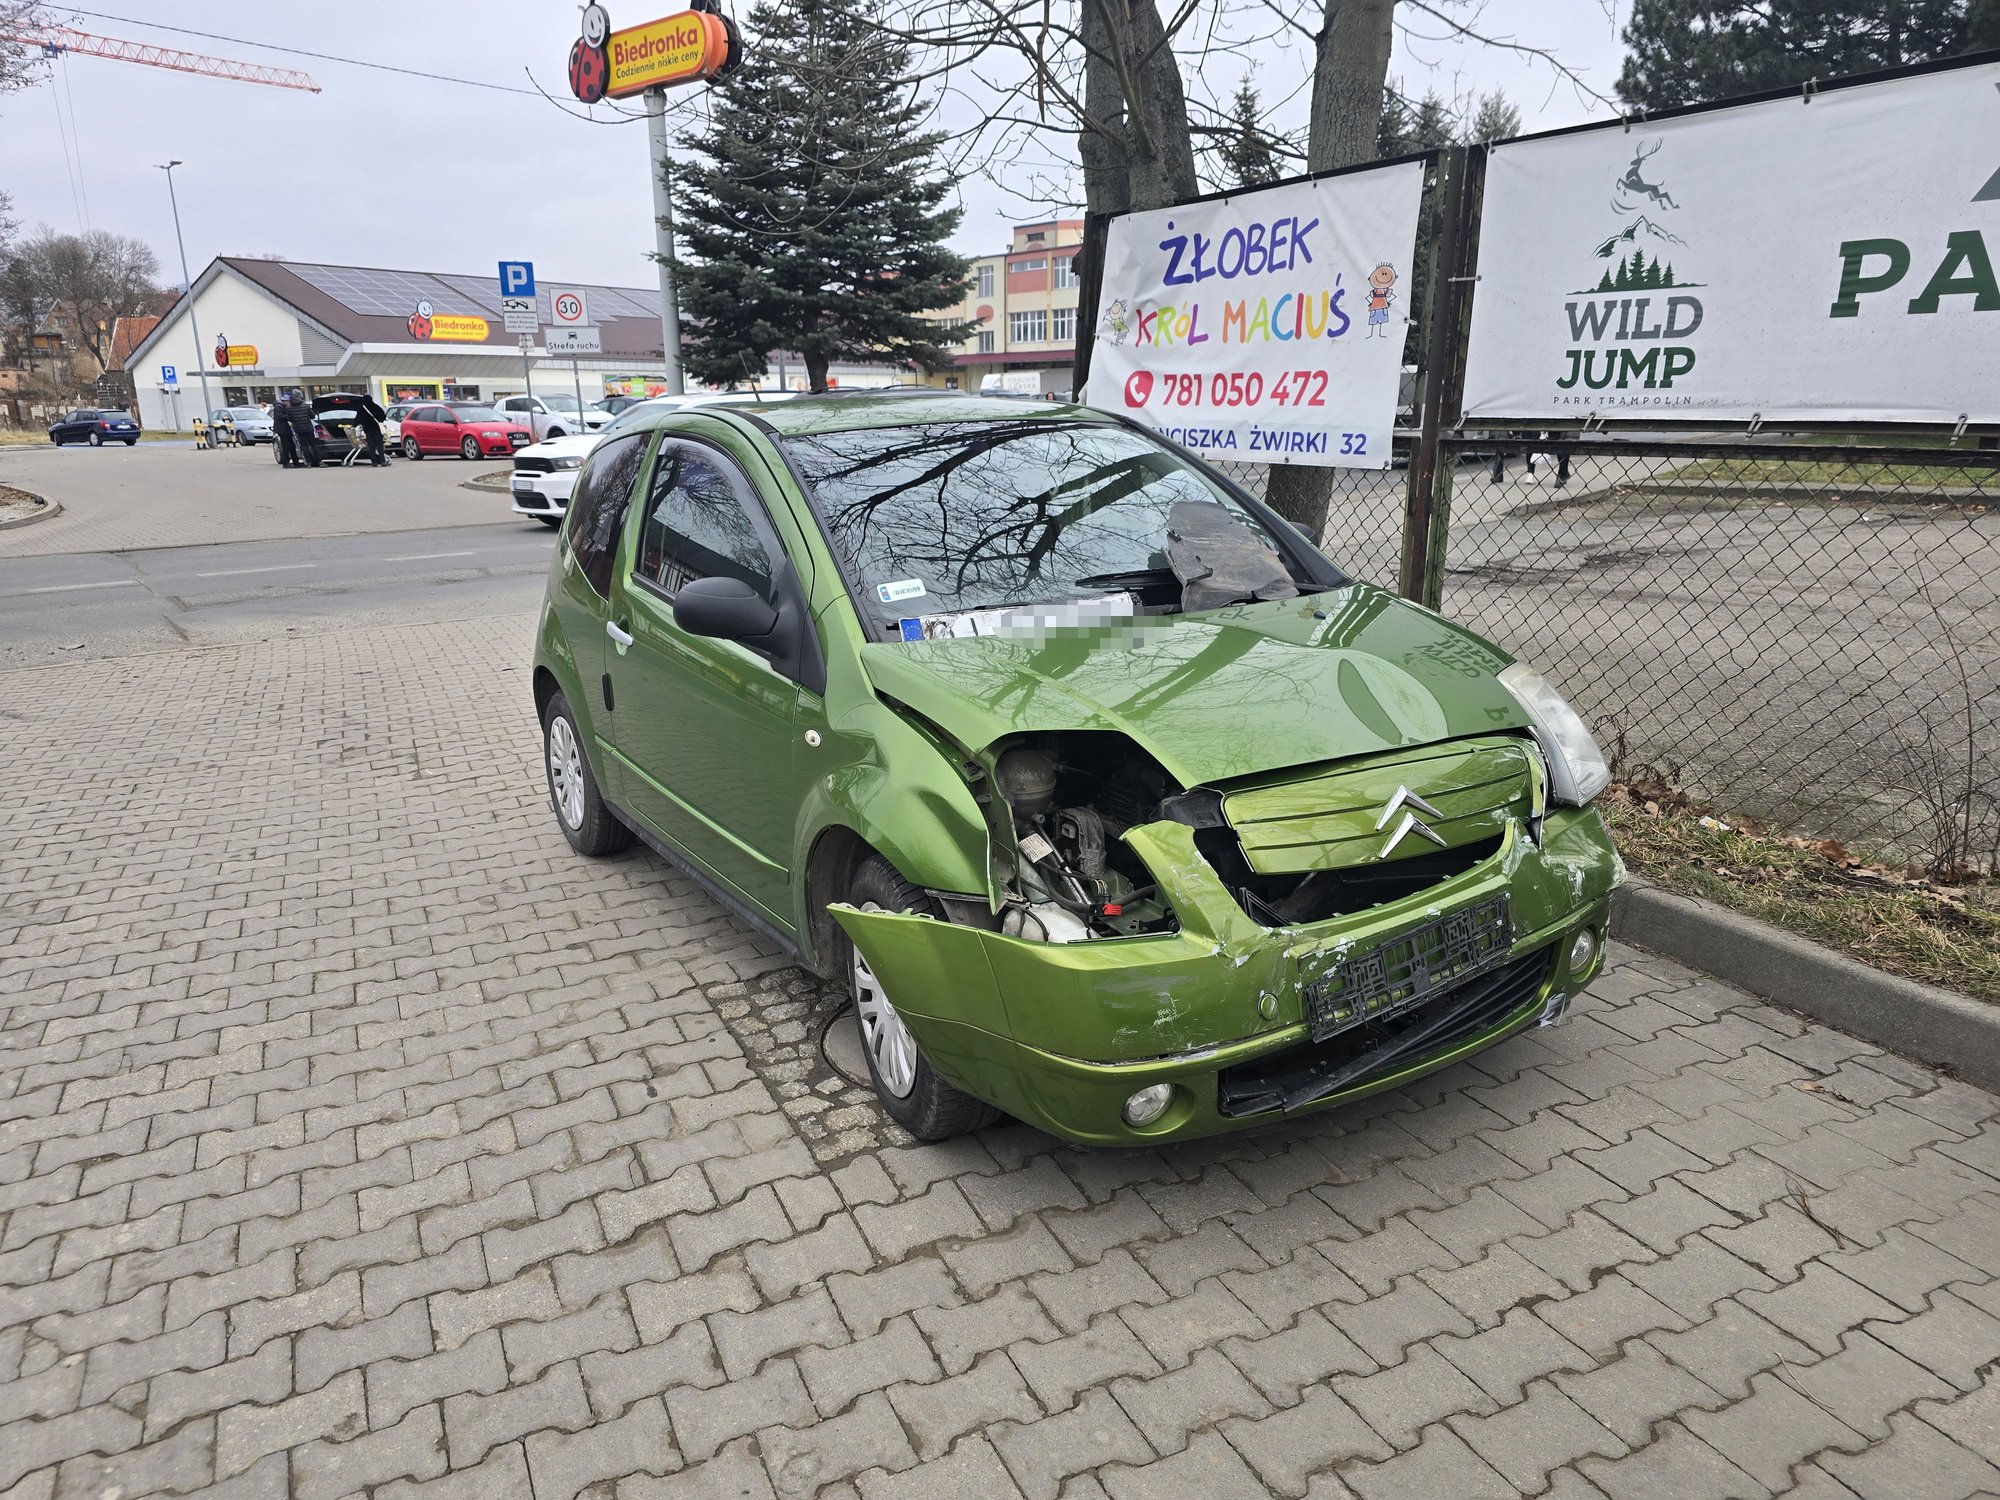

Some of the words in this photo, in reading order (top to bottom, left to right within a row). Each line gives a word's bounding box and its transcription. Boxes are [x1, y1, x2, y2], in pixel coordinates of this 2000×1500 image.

[614, 26, 698, 66] Biedronka
[616, 60, 655, 79] Codziennie
[658, 54, 679, 67] niskie
[681, 50, 699, 63] ceny
[1159, 216, 1319, 286] ŻŁOBEK
[506, 265, 528, 293] P
[559, 301, 578, 314] 30
[1135, 301, 1209, 348] KRÓL
[1221, 273, 1350, 344] MACIUŚ
[1565, 295, 1703, 342] WILD
[434, 319, 484, 331] Biedronka
[548, 342, 574, 350] Strefa
[577, 342, 600, 350] ruchu
[164, 367, 173, 379] P
[1556, 346, 1696, 390] JUMP
[1162, 373, 1202, 406] 781
[1211, 372, 1264, 406] 050
[1270, 369, 1329, 407] 472
[1553, 396, 1591, 405] PARK
[1600, 396, 1692, 405] TRAMPOLIN
[1249, 424, 1327, 454] ŻWIRKI
[1340, 433, 1367, 456] 32
